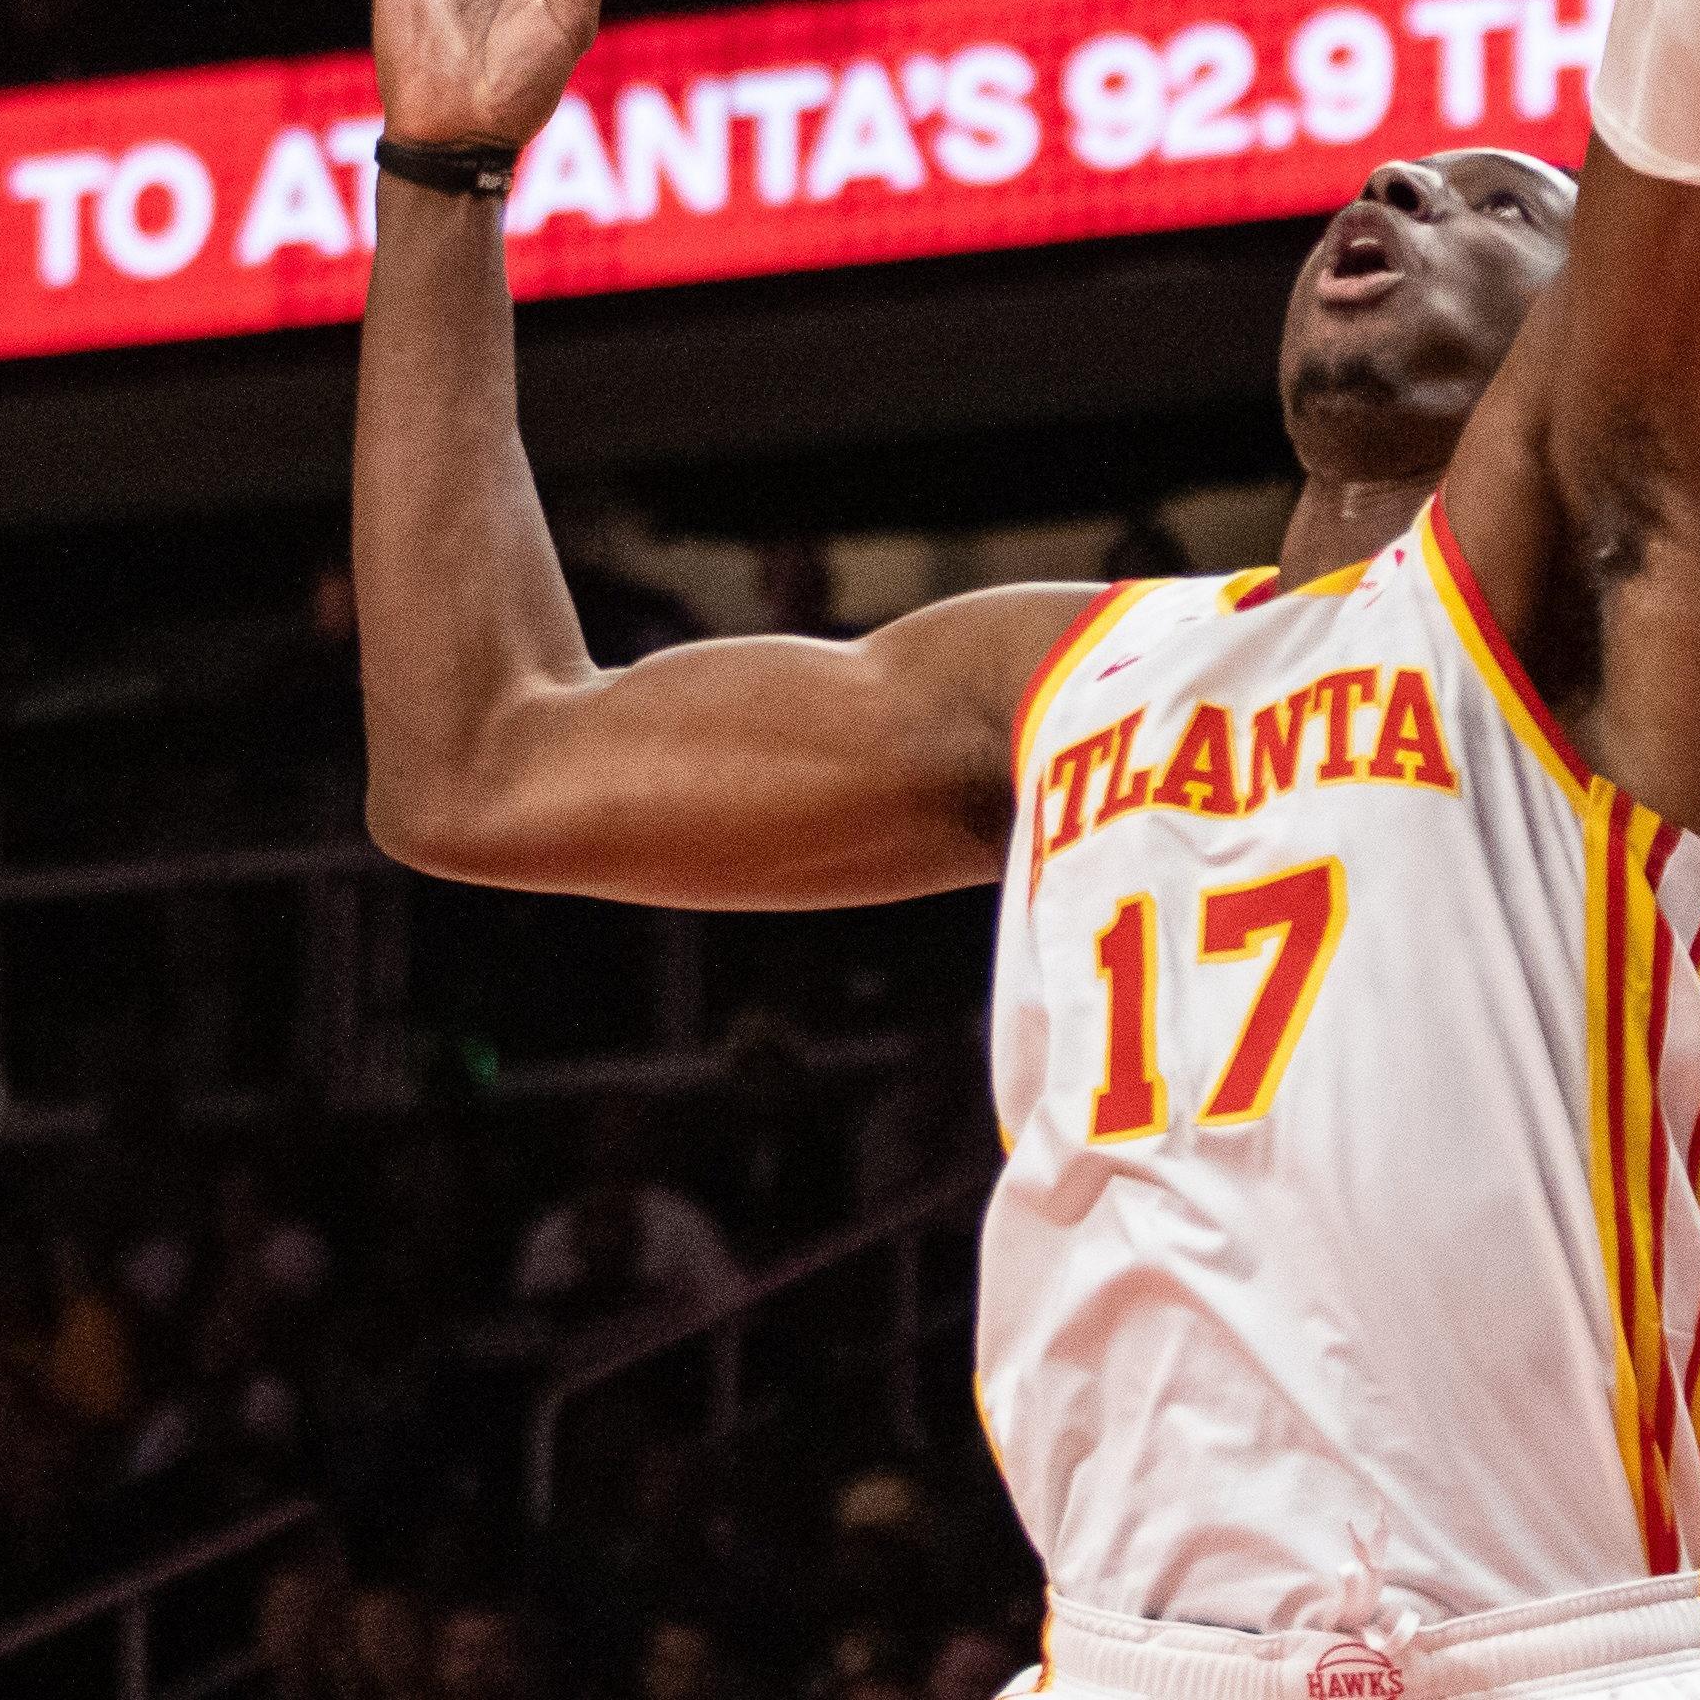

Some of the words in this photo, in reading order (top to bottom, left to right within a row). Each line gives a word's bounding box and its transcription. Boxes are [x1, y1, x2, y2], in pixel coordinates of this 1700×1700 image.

[7, 140, 216, 287] TO
[235, 41, 1041, 267] ATANTA'S
[1063, 6, 1396, 171] 92.9
[1028, 664, 1463, 910] TLANTA
[1086, 854, 1349, 1146] 17
[1306, 1669, 1404, 1699] HAWKS
